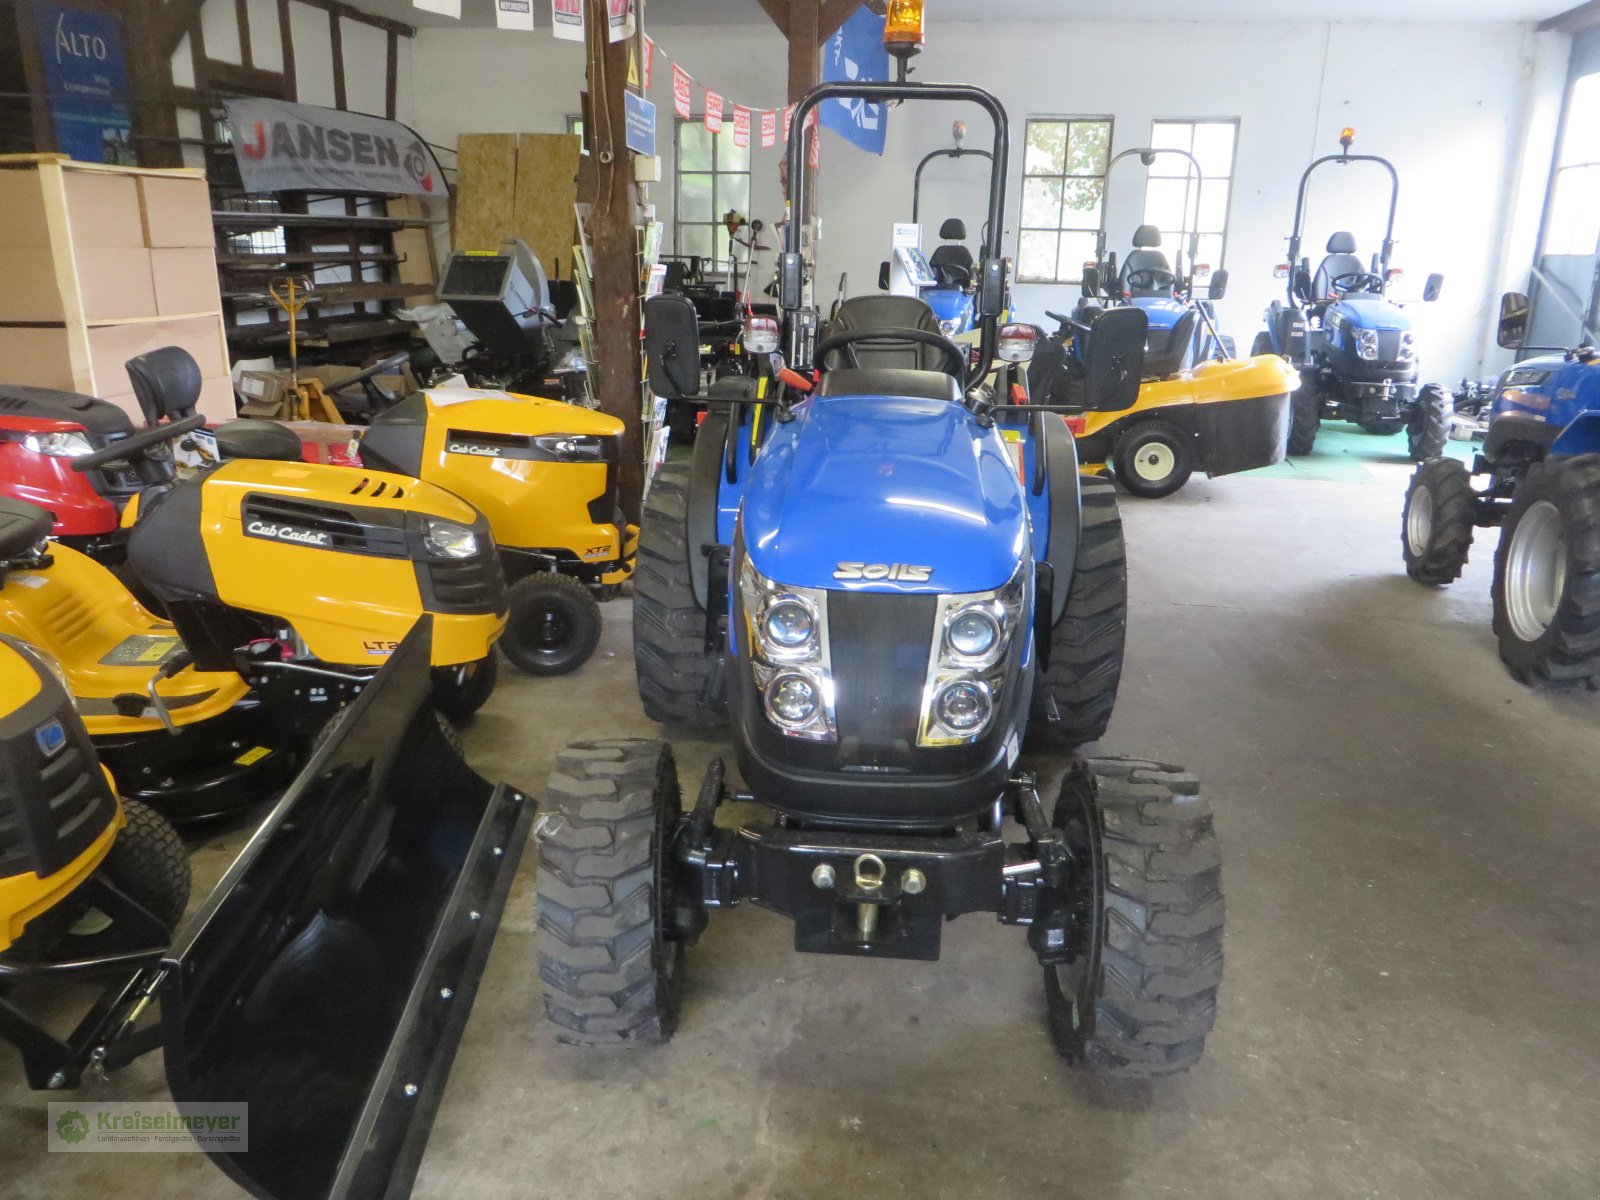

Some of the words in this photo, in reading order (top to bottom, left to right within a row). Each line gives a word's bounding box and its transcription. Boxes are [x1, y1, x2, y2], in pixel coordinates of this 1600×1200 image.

[56, 12, 106, 65] ALTO
[243, 121, 400, 167] JANSEN
[450, 444, 468, 453] Cub
[469, 446, 501, 456] Cadet
[248, 521, 278, 537] Cub
[278, 526, 328, 546] Cadet
[833, 561, 932, 583] Solis
